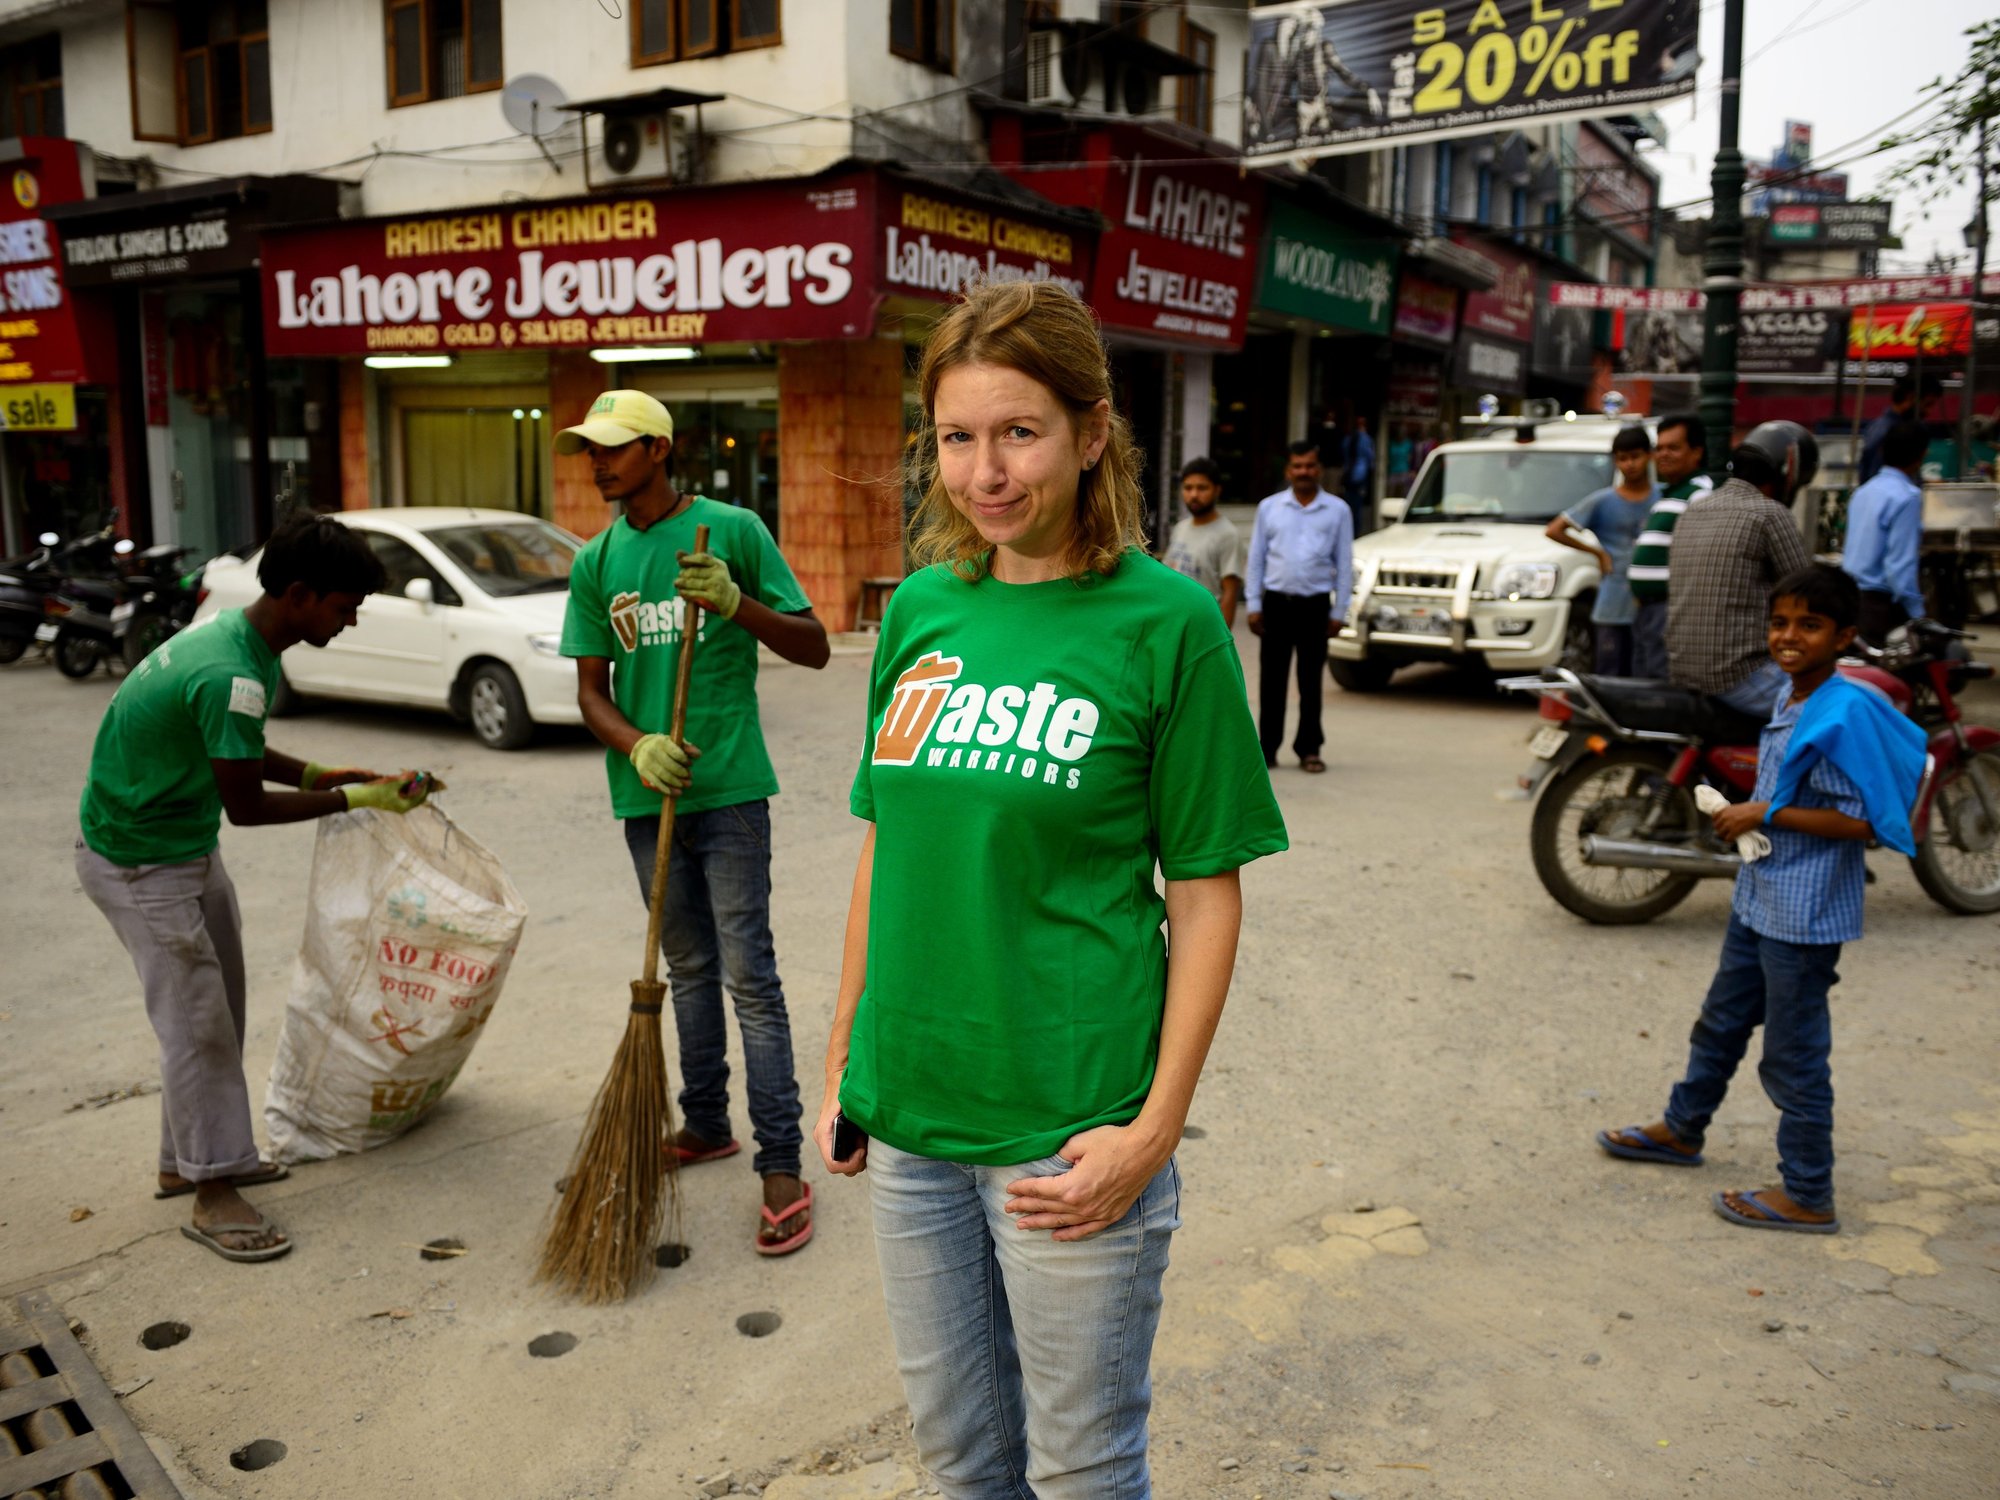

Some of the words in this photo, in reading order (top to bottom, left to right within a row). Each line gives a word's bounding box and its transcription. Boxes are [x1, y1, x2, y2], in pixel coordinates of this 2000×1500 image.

[1387, 52, 1416, 118] Flat
[1125, 152, 1250, 258] LAHORE
[1821, 205, 1888, 224] CENTRAL
[169, 225, 184, 252] &
[184, 218, 229, 250] SONS
[384, 214, 502, 258] RAMESH
[511, 200, 657, 247] CHANDER
[902, 192, 990, 246] RAMESH
[991, 217, 1073, 265] CHANDER
[1828, 223, 1876, 240] HOTEL
[275, 264, 494, 328] Lahore
[504, 237, 853, 319] Jewellers
[1117, 248, 1239, 320] JEWELLERS
[1273, 236, 1370, 304] WOODLAND
[366, 324, 440, 349] DIAMOND
[442, 322, 496, 345] GOLD
[500, 321, 516, 348] &
[519, 316, 588, 343] SILVER
[591, 313, 707, 341] JEWELLERY
[1739, 312, 1829, 335] VEGAS
[8, 390, 58, 426] sale
[927, 747, 1081, 790] WARRIORS
[377, 939, 418, 966] NO
